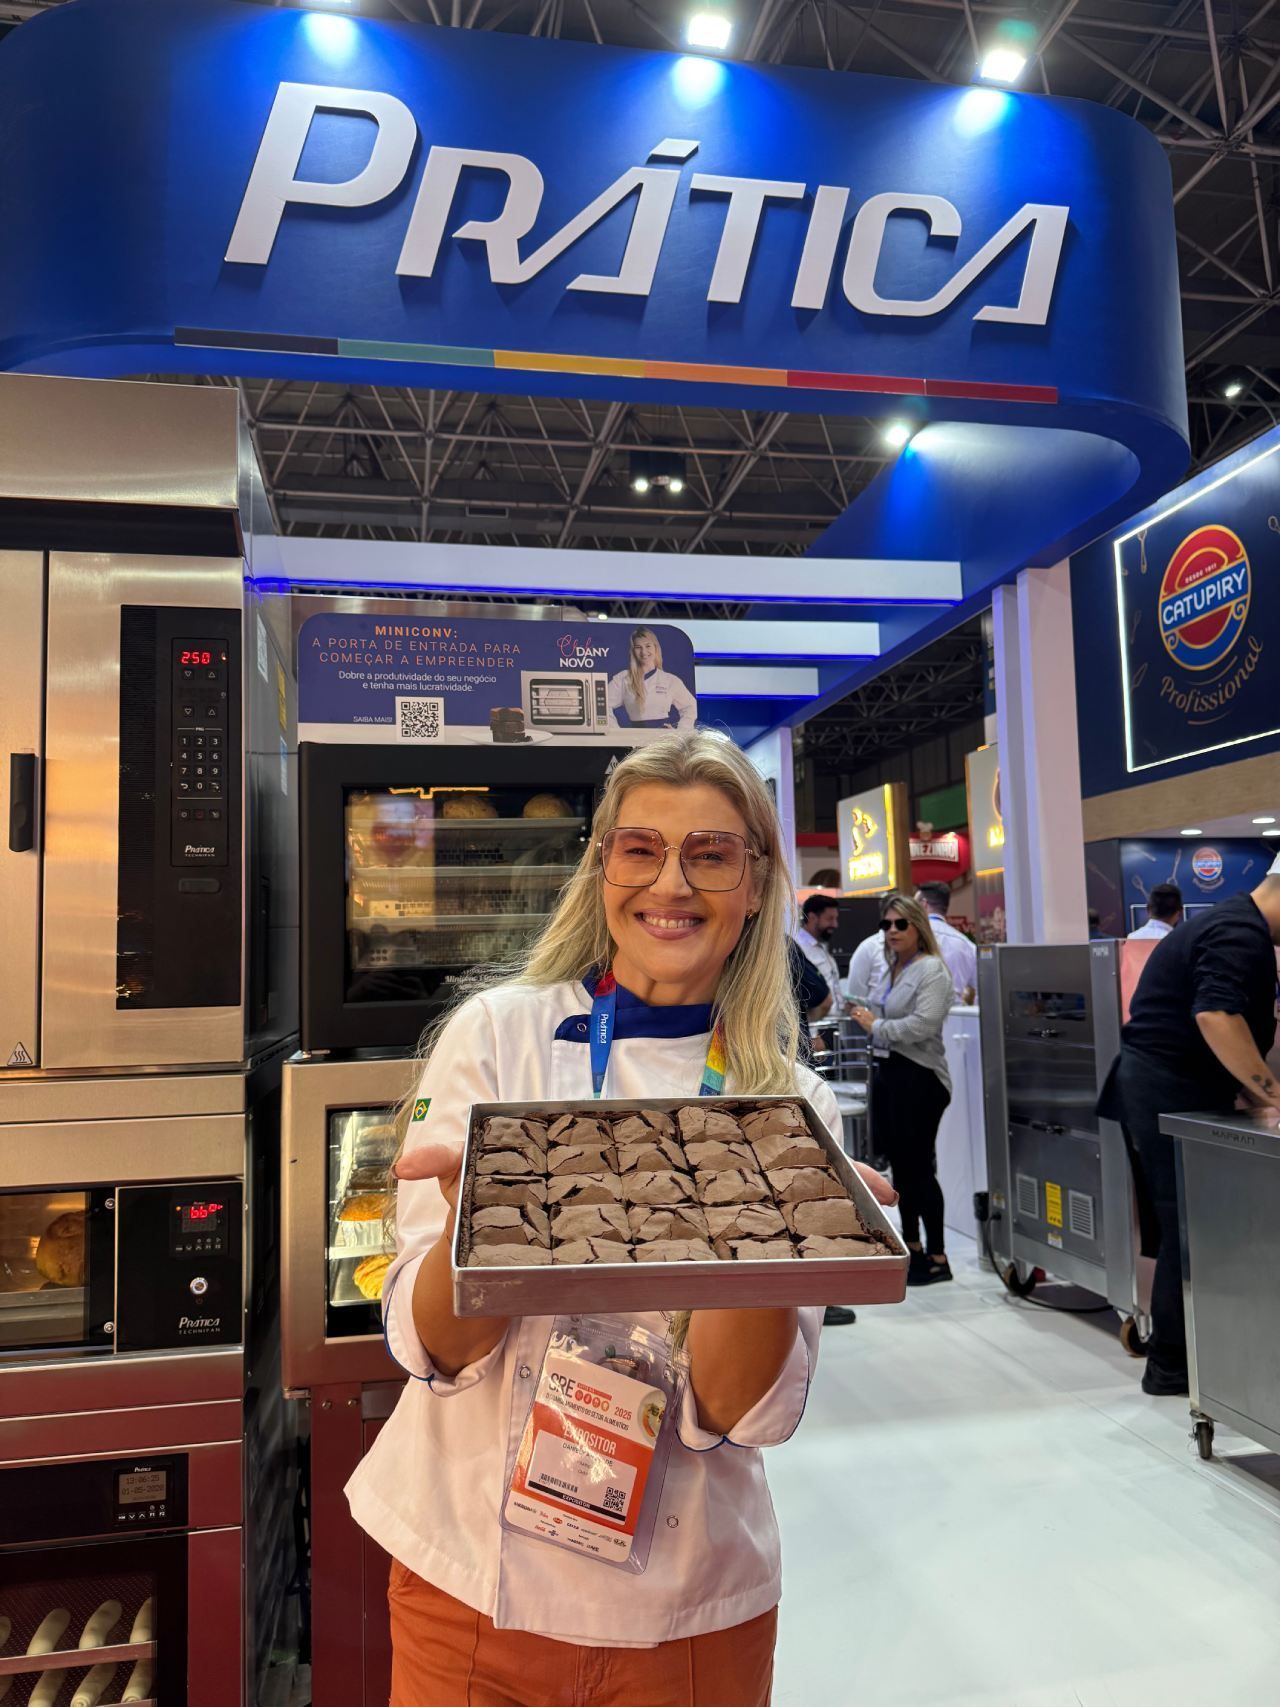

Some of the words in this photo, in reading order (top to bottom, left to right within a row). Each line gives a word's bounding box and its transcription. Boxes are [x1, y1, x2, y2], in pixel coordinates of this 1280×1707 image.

[223, 80, 1071, 327] PRÁTICA
[1162, 567, 1247, 625] CATUPIRY
[375, 625, 458, 639] MINICONV:
[312, 637, 321, 648] A
[328, 638, 378, 650] PORTA
[384, 640, 403, 651] DE
[409, 641, 478, 653] ENTRADA
[484, 643, 521, 654] PARA
[576, 646, 610, 657] DANY
[180, 650, 211, 665] 250
[319, 652, 394, 667] COMEÇAR
[400, 655, 410, 665] A
[416, 655, 515, 668] EMPREENDER
[559, 656, 594, 668] NOVO
[338, 670, 366, 680] Dobre
[374, 672, 433, 682] produtividade
[433, 673, 446, 682] do
[463, 674, 497, 685] negócio
[1160, 635, 1264, 714] Profissional
[370, 681, 395, 690] tenha
[396, 682, 418, 691] mais
[353, 715, 374, 723] SAIBA
[182, 737, 187, 745] 1
[197, 737, 203, 745] 2
[212, 737, 218, 745] 3
[181, 752, 187, 760] 4
[197, 752, 203, 760] 5
[212, 752, 218, 760] 6
[181, 767, 187, 775] 7
[197, 767, 203, 775] 8
[212, 767, 218, 775] 9
[178, 1316, 221, 1329] PRÁTICA
[548, 1372, 576, 1399] SRE
[614, 1406, 633, 1421] 2025
[563, 1420, 617, 1456] EXPOSITOR
